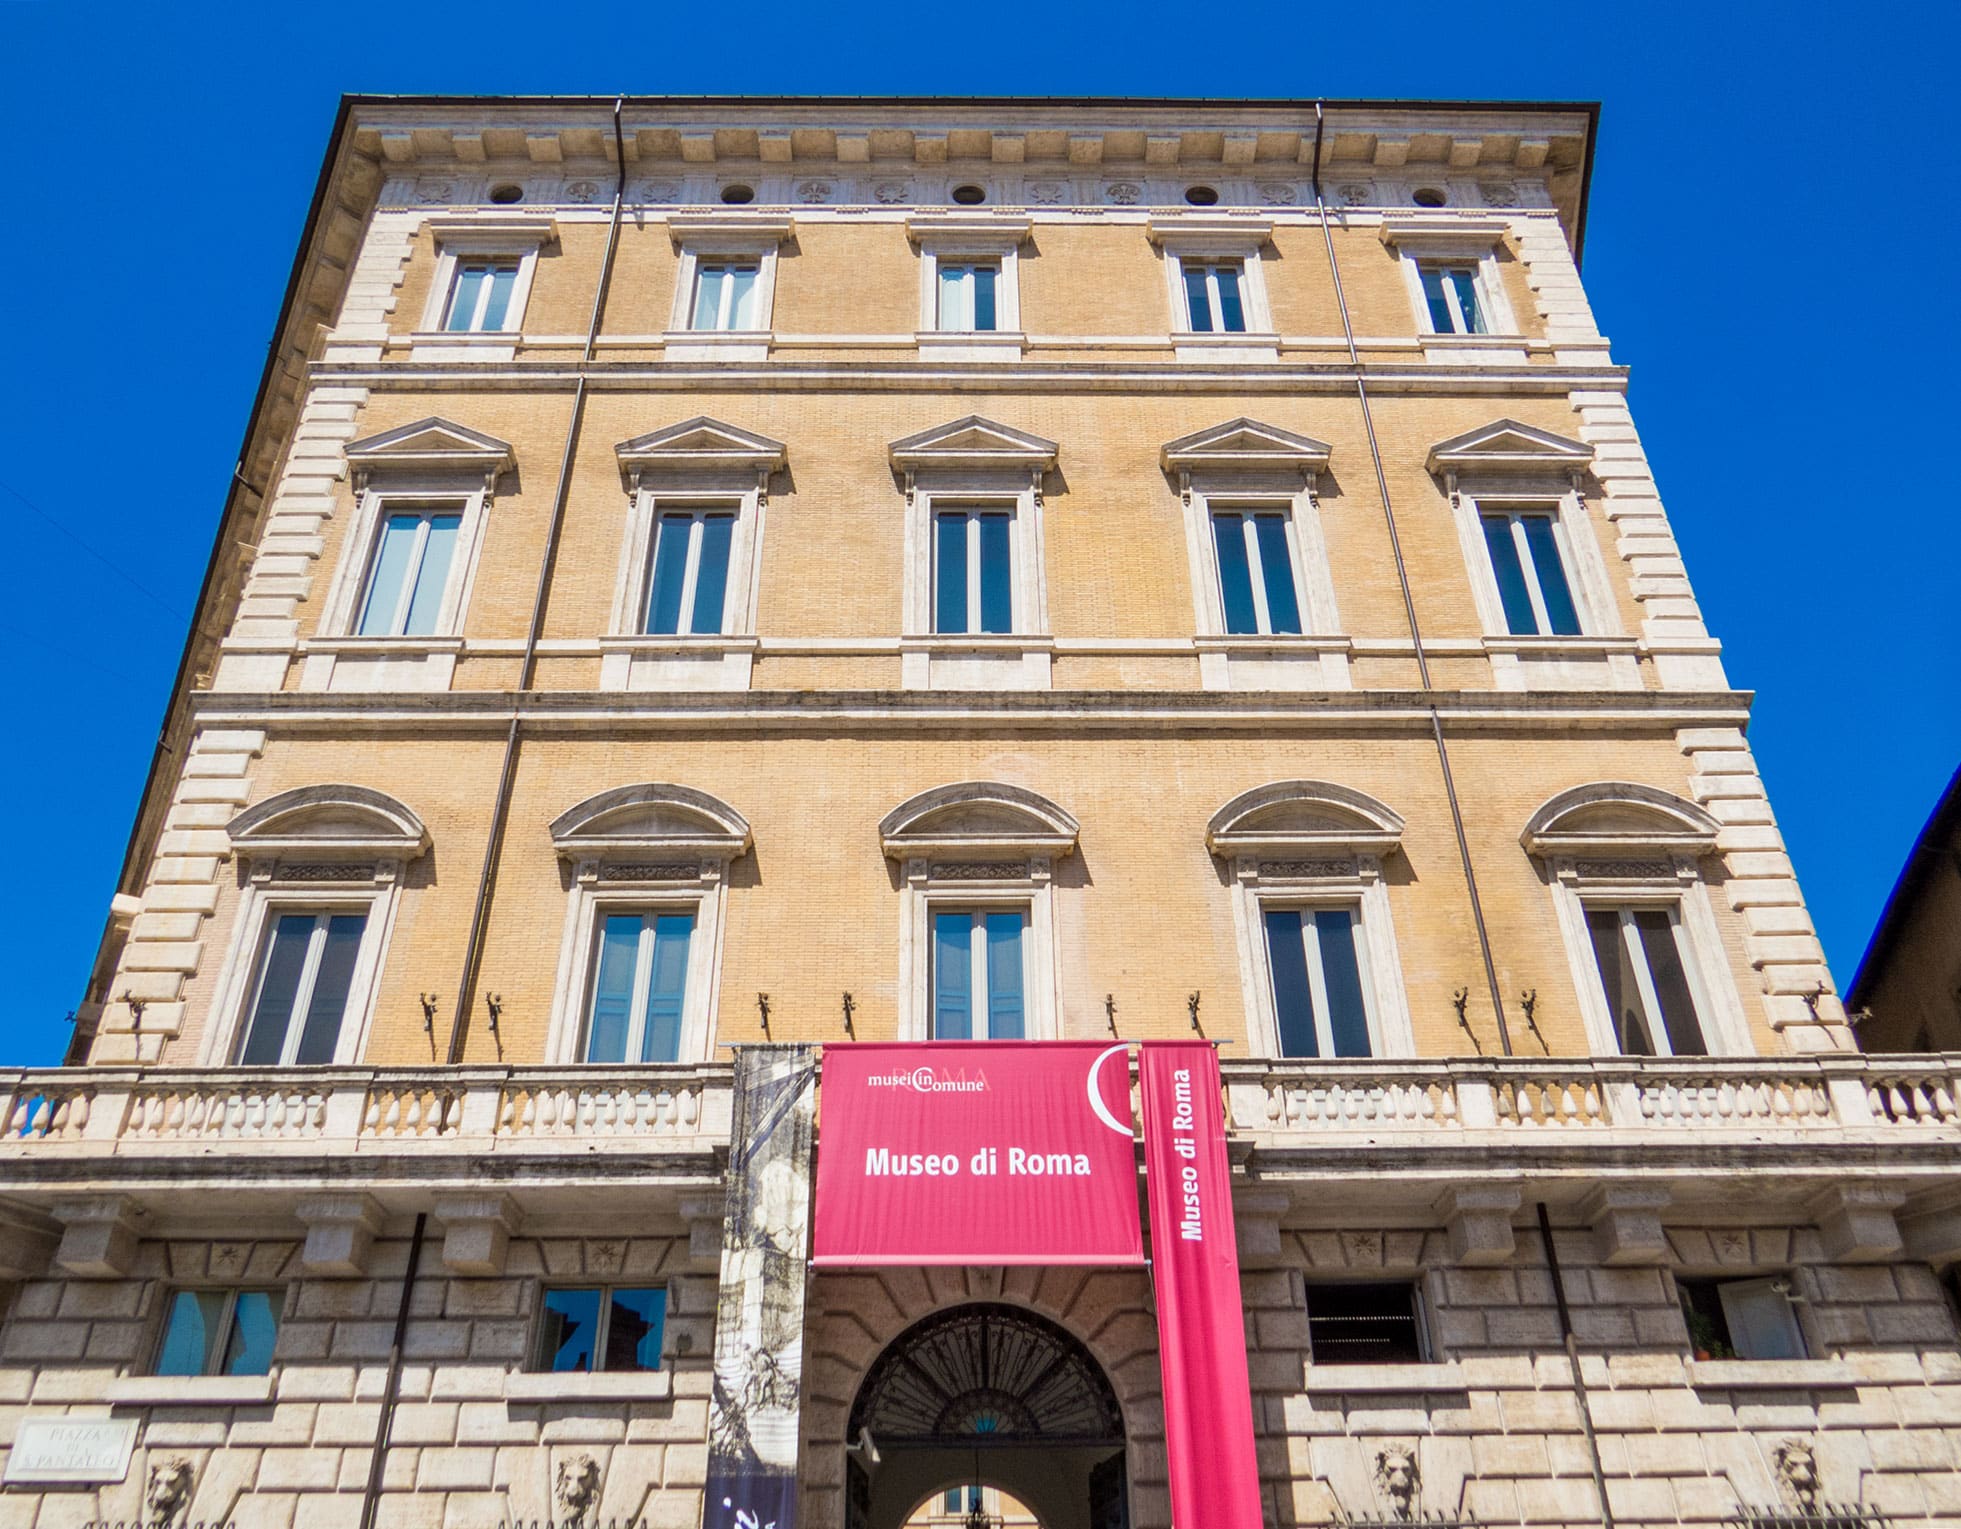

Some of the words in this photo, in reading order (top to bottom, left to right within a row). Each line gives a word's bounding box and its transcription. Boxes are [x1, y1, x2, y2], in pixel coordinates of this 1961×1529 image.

[868, 1072, 911, 1087] musei
[912, 1066, 985, 1092] Comune
[918, 1072, 932, 1085] in
[1172, 1069, 1194, 1131] Roma
[1174, 1138, 1197, 1160] di
[865, 1147, 960, 1176] Museo
[970, 1147, 997, 1176] di
[1008, 1147, 1091, 1176] Roma
[1180, 1166, 1202, 1241] Museo
[49, 1428, 101, 1441] PIAZZA
